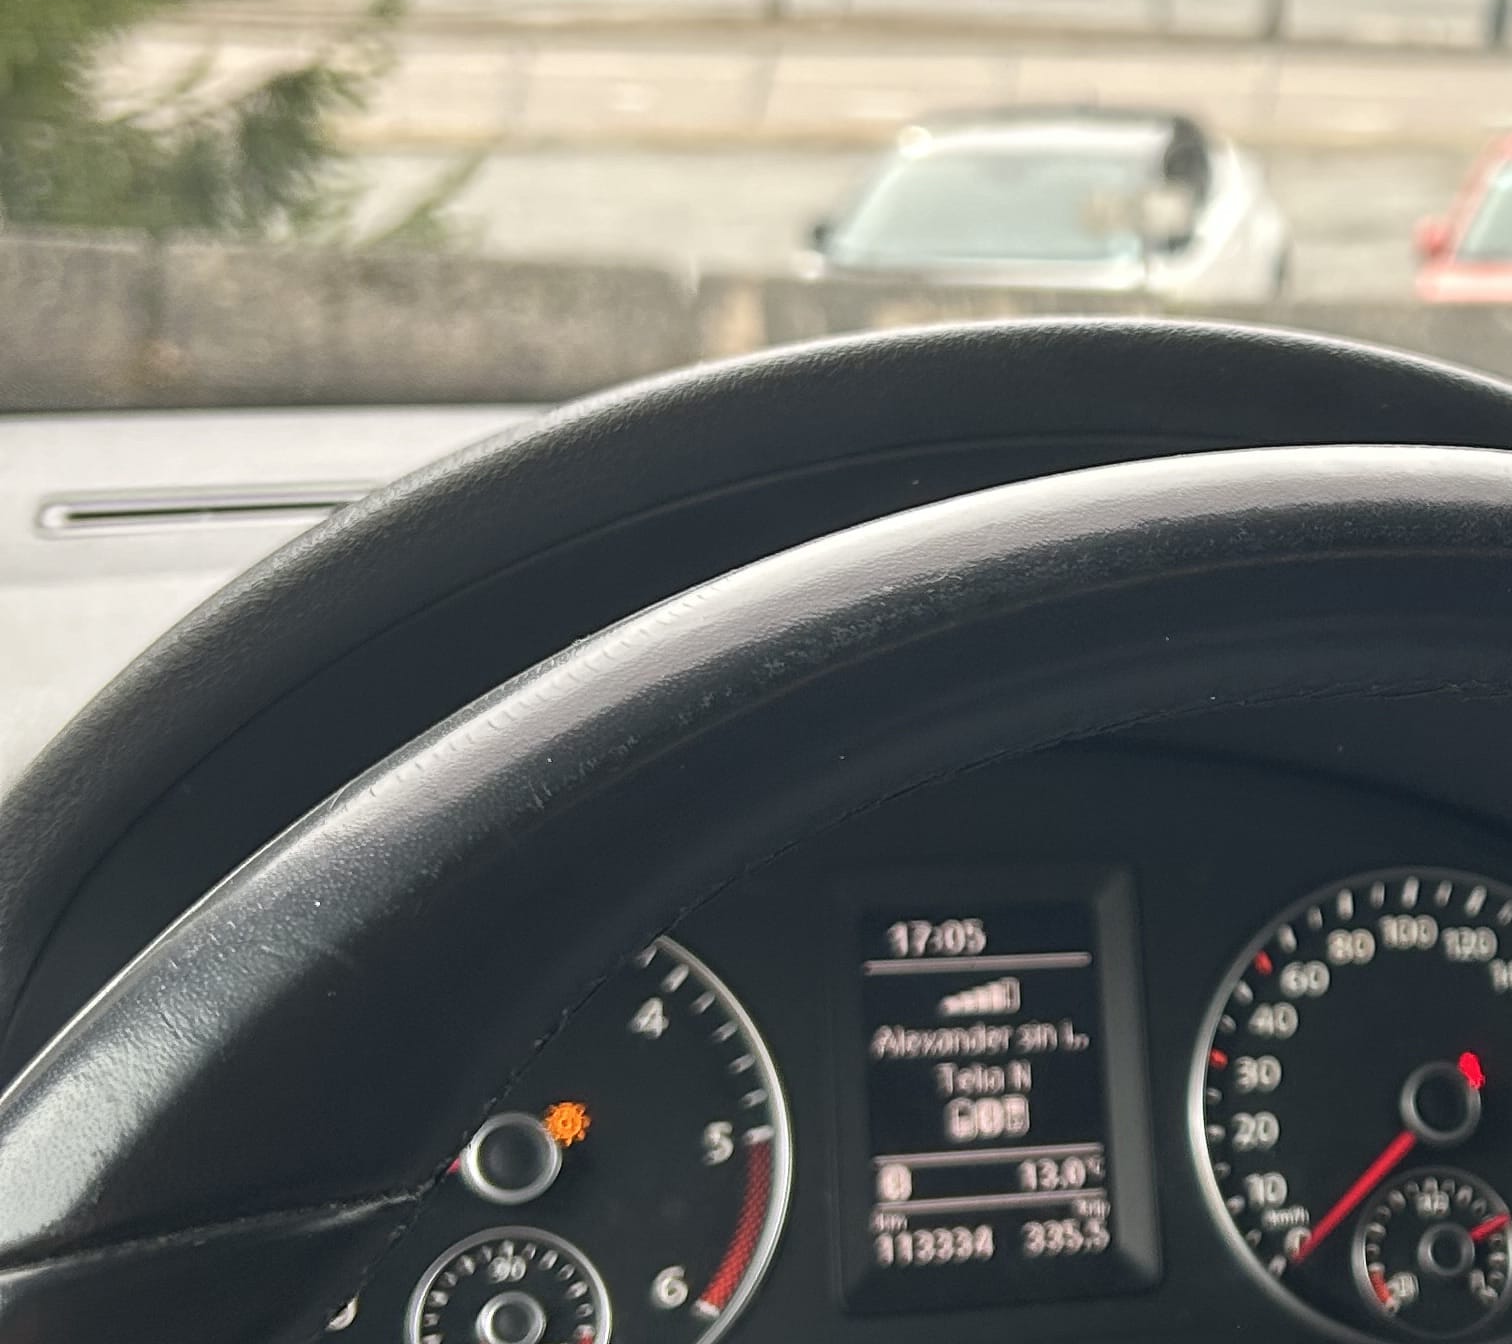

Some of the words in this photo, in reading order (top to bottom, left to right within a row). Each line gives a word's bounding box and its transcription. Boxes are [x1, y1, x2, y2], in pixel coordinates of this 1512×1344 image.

[887, 918, 987, 956] 17:05
[1327, 928, 1375, 965] 80
[1379, 914, 1438, 949] 100
[1441, 926, 1497, 961] 120
[1280, 961, 1330, 998] 60
[633, 997, 670, 1039] 4
[1249, 1001, 1298, 1040] 40
[1235, 1054, 1282, 1092] 30
[702, 1120, 733, 1165] 5
[1231, 1111, 1280, 1150] 20
[1245, 1172, 1287, 1209] 10
[652, 1265, 690, 1309] 6
